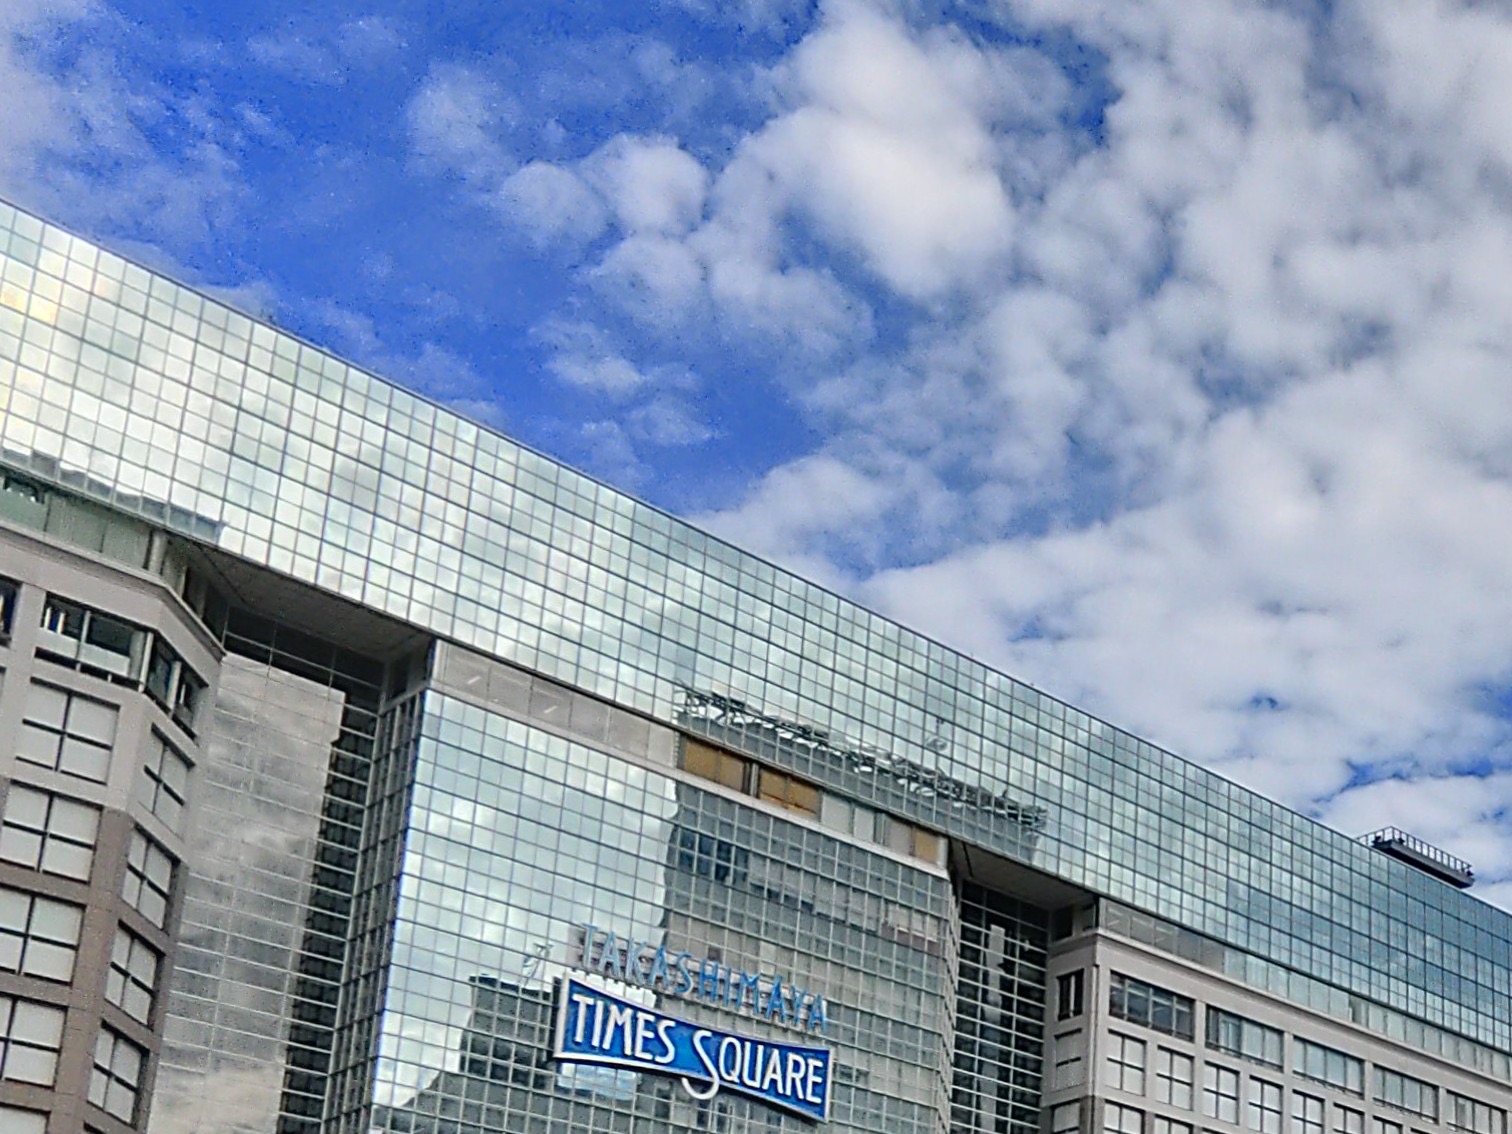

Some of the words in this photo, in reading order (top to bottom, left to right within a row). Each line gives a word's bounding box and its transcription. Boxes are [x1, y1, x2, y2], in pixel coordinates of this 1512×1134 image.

[581, 924, 827, 1032] TAKASHIMAYA
[571, 993, 677, 1064] TIMES
[681, 1029, 824, 1103] SQUARE
